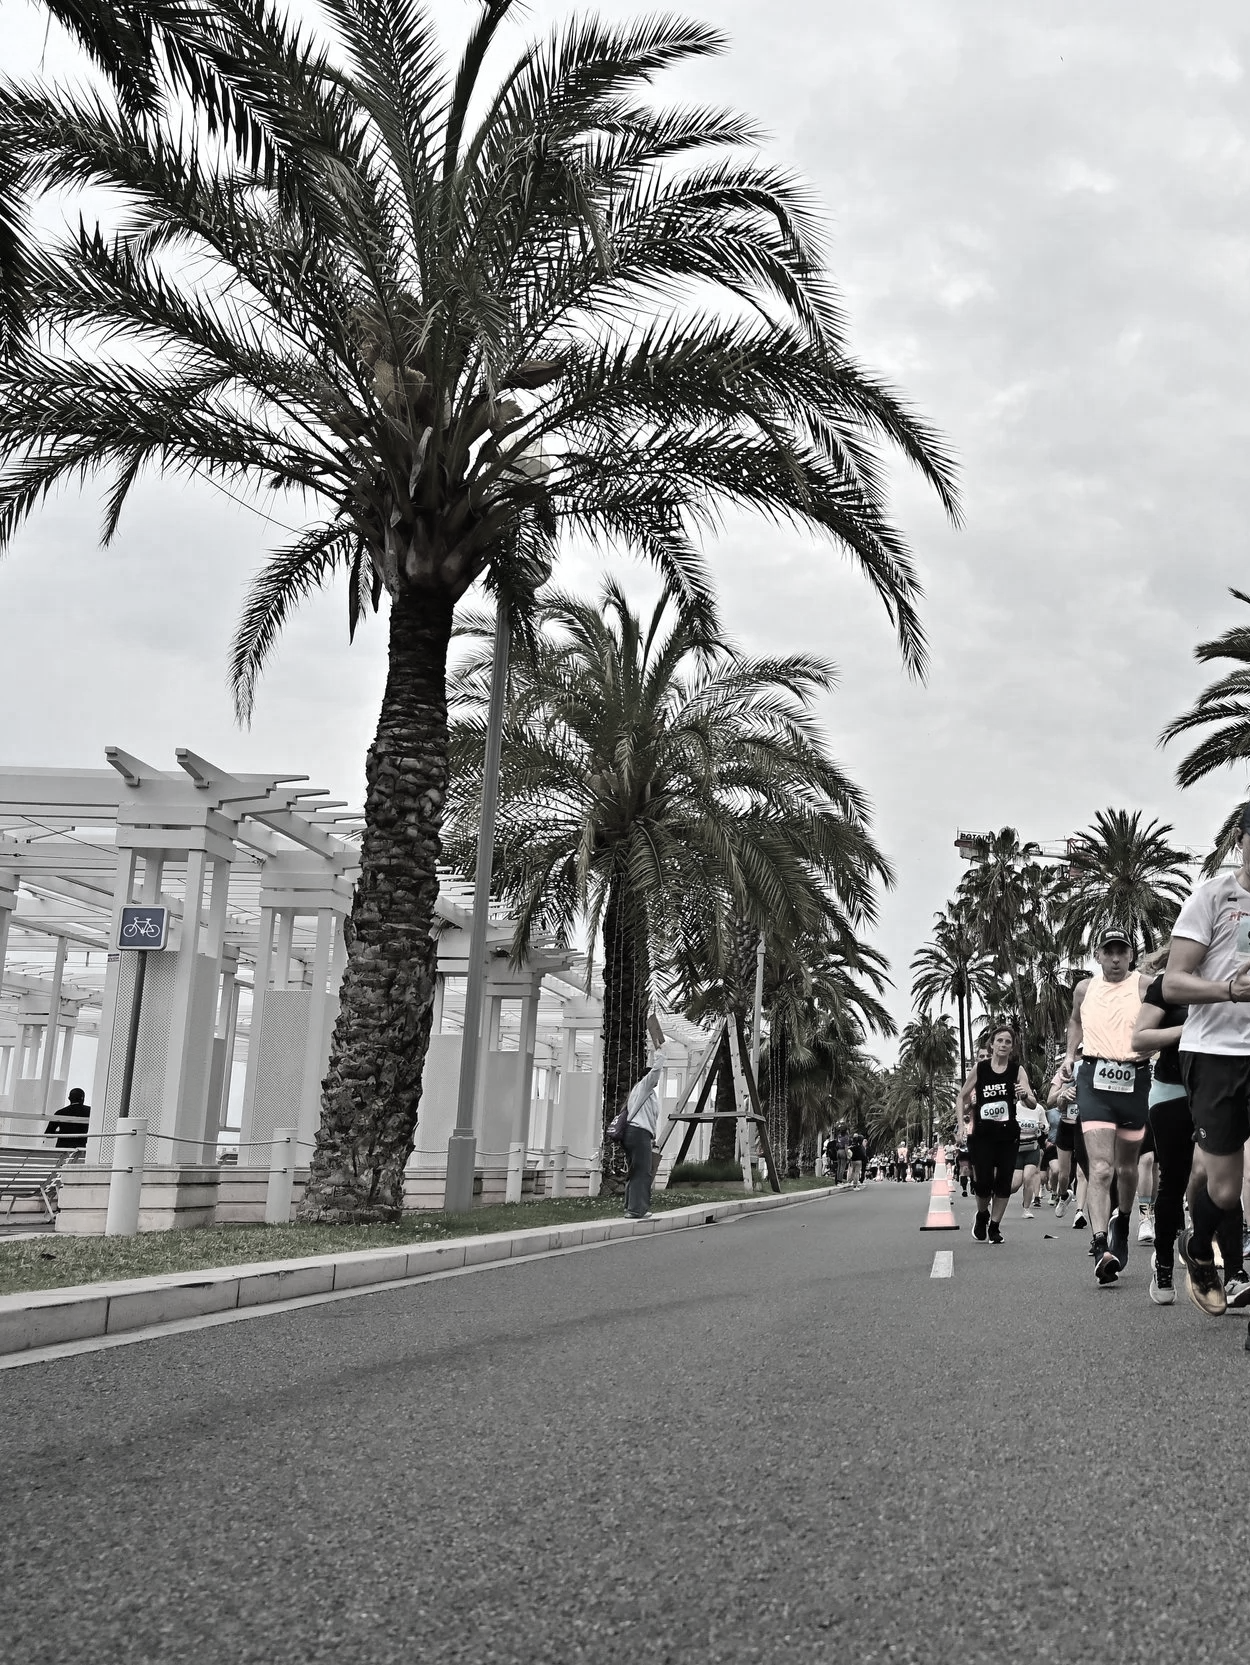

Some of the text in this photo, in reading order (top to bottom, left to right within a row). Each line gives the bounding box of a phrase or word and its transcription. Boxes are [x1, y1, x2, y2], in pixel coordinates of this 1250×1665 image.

[1099, 1067, 1131, 1081] 4600
[982, 1083, 1007, 1092] JUST
[983, 1090, 997, 1098] DO
[983, 1106, 1005, 1116] 5000
